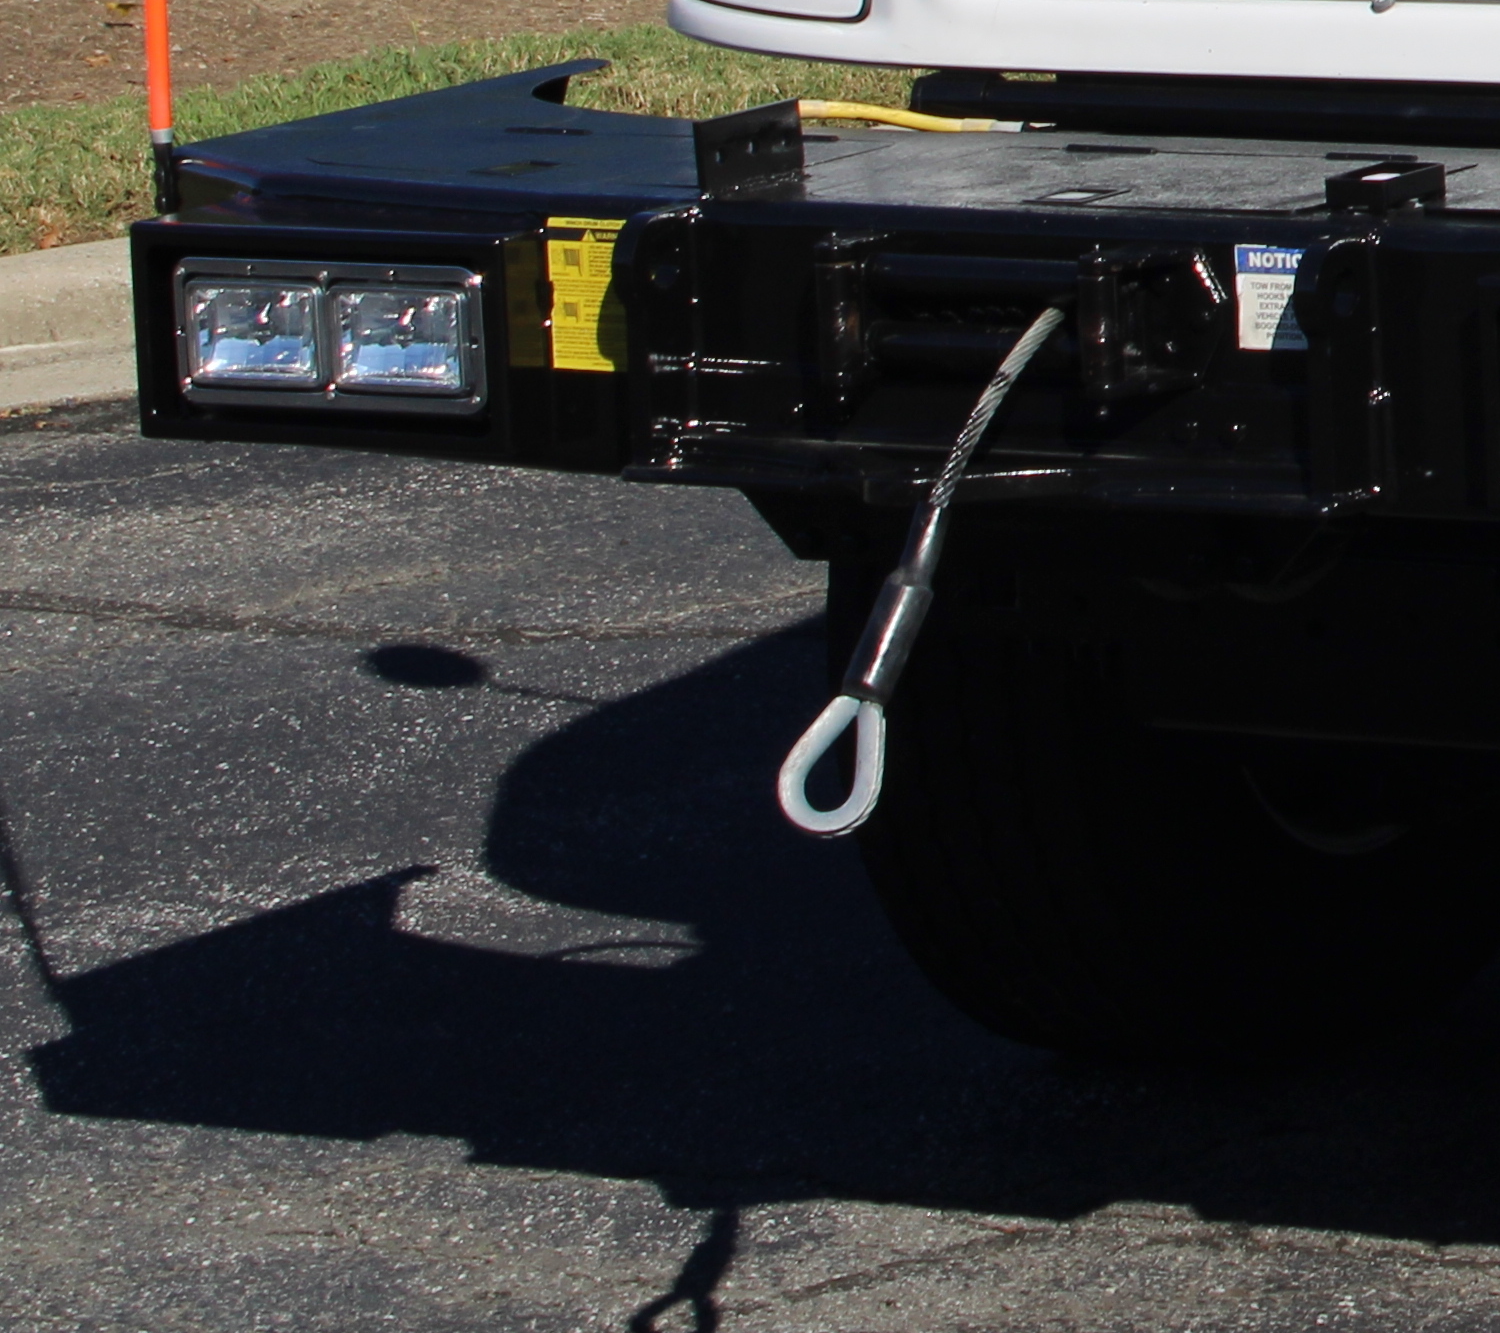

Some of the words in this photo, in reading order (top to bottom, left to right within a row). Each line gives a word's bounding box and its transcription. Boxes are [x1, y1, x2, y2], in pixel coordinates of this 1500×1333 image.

[1248, 251, 1303, 269] NOTIC
[1250, 282, 1268, 290] TOW
[1270, 282, 1292, 291] FROM
[1257, 292, 1285, 301] HOOKS
